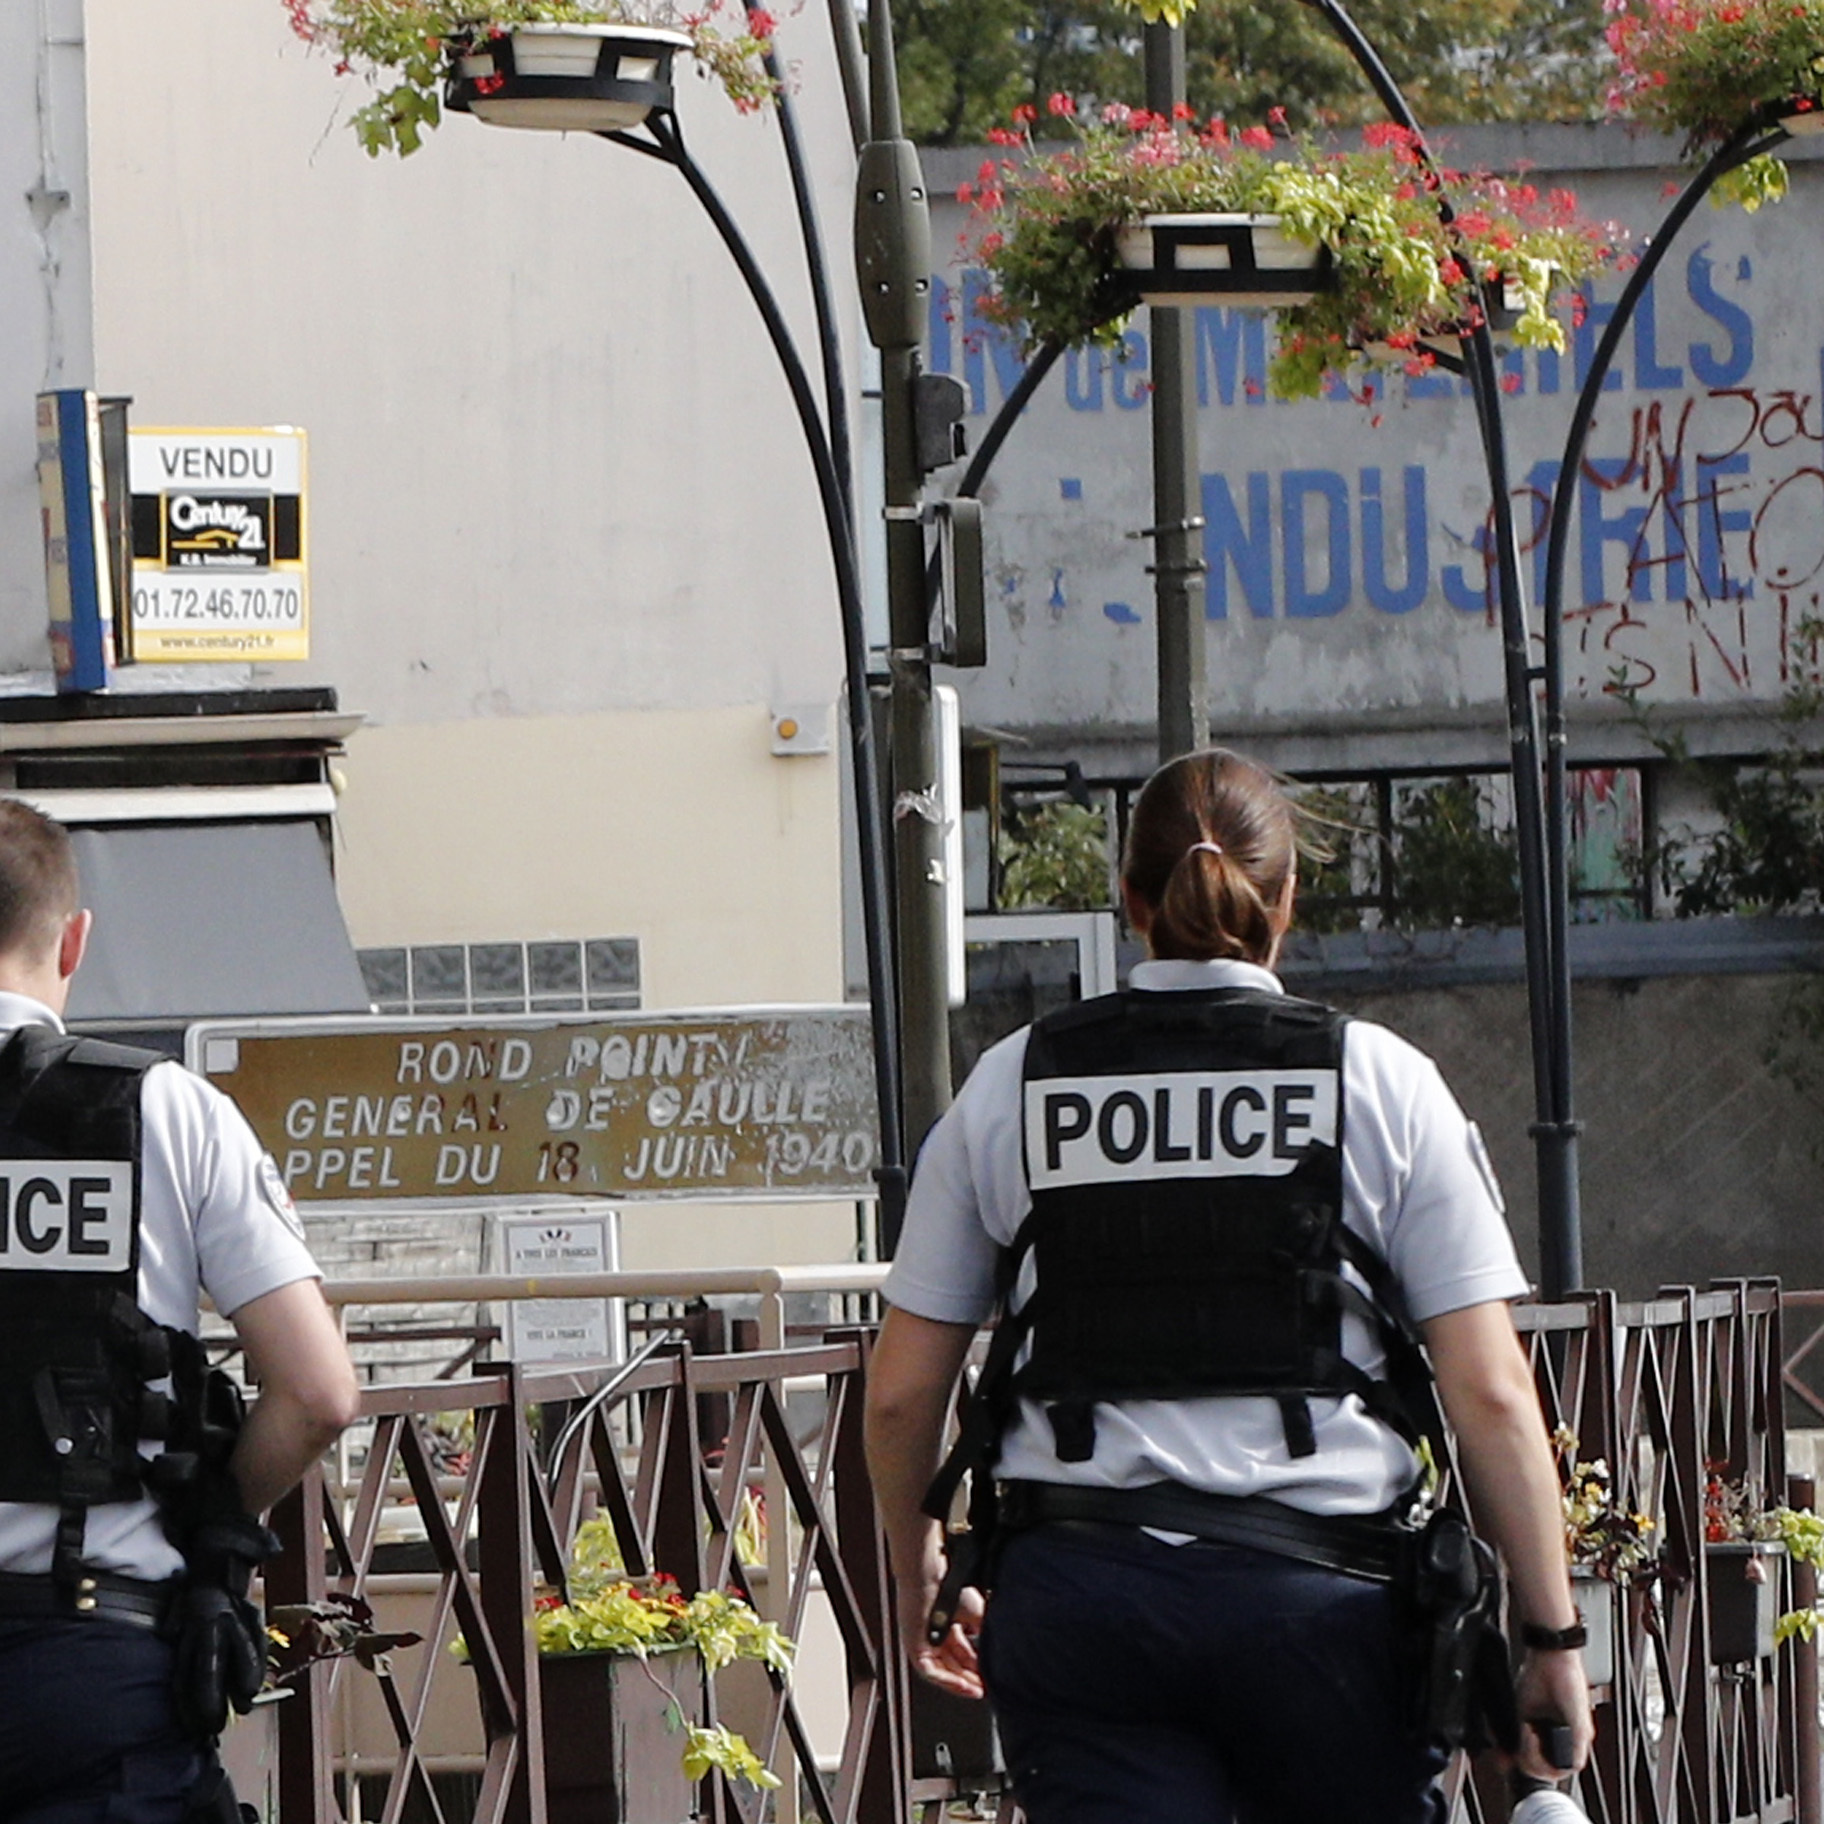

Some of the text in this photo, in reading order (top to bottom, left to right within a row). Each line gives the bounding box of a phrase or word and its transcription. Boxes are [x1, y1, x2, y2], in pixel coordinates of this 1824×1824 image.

[159, 447, 273, 478] VENDU
[238, 515, 266, 549] 21
[134, 588, 298, 619] 01.72.46.70.70
[160, 633, 275, 652] www.century21.fr
[397, 1032, 714, 1084] ROND POINT
[285, 1078, 832, 1140] GENERAL DE GAULLE
[1042, 1083, 1316, 1171] POLICE
[282, 1131, 874, 1190] PPEL DU 18 JUIN 1940
